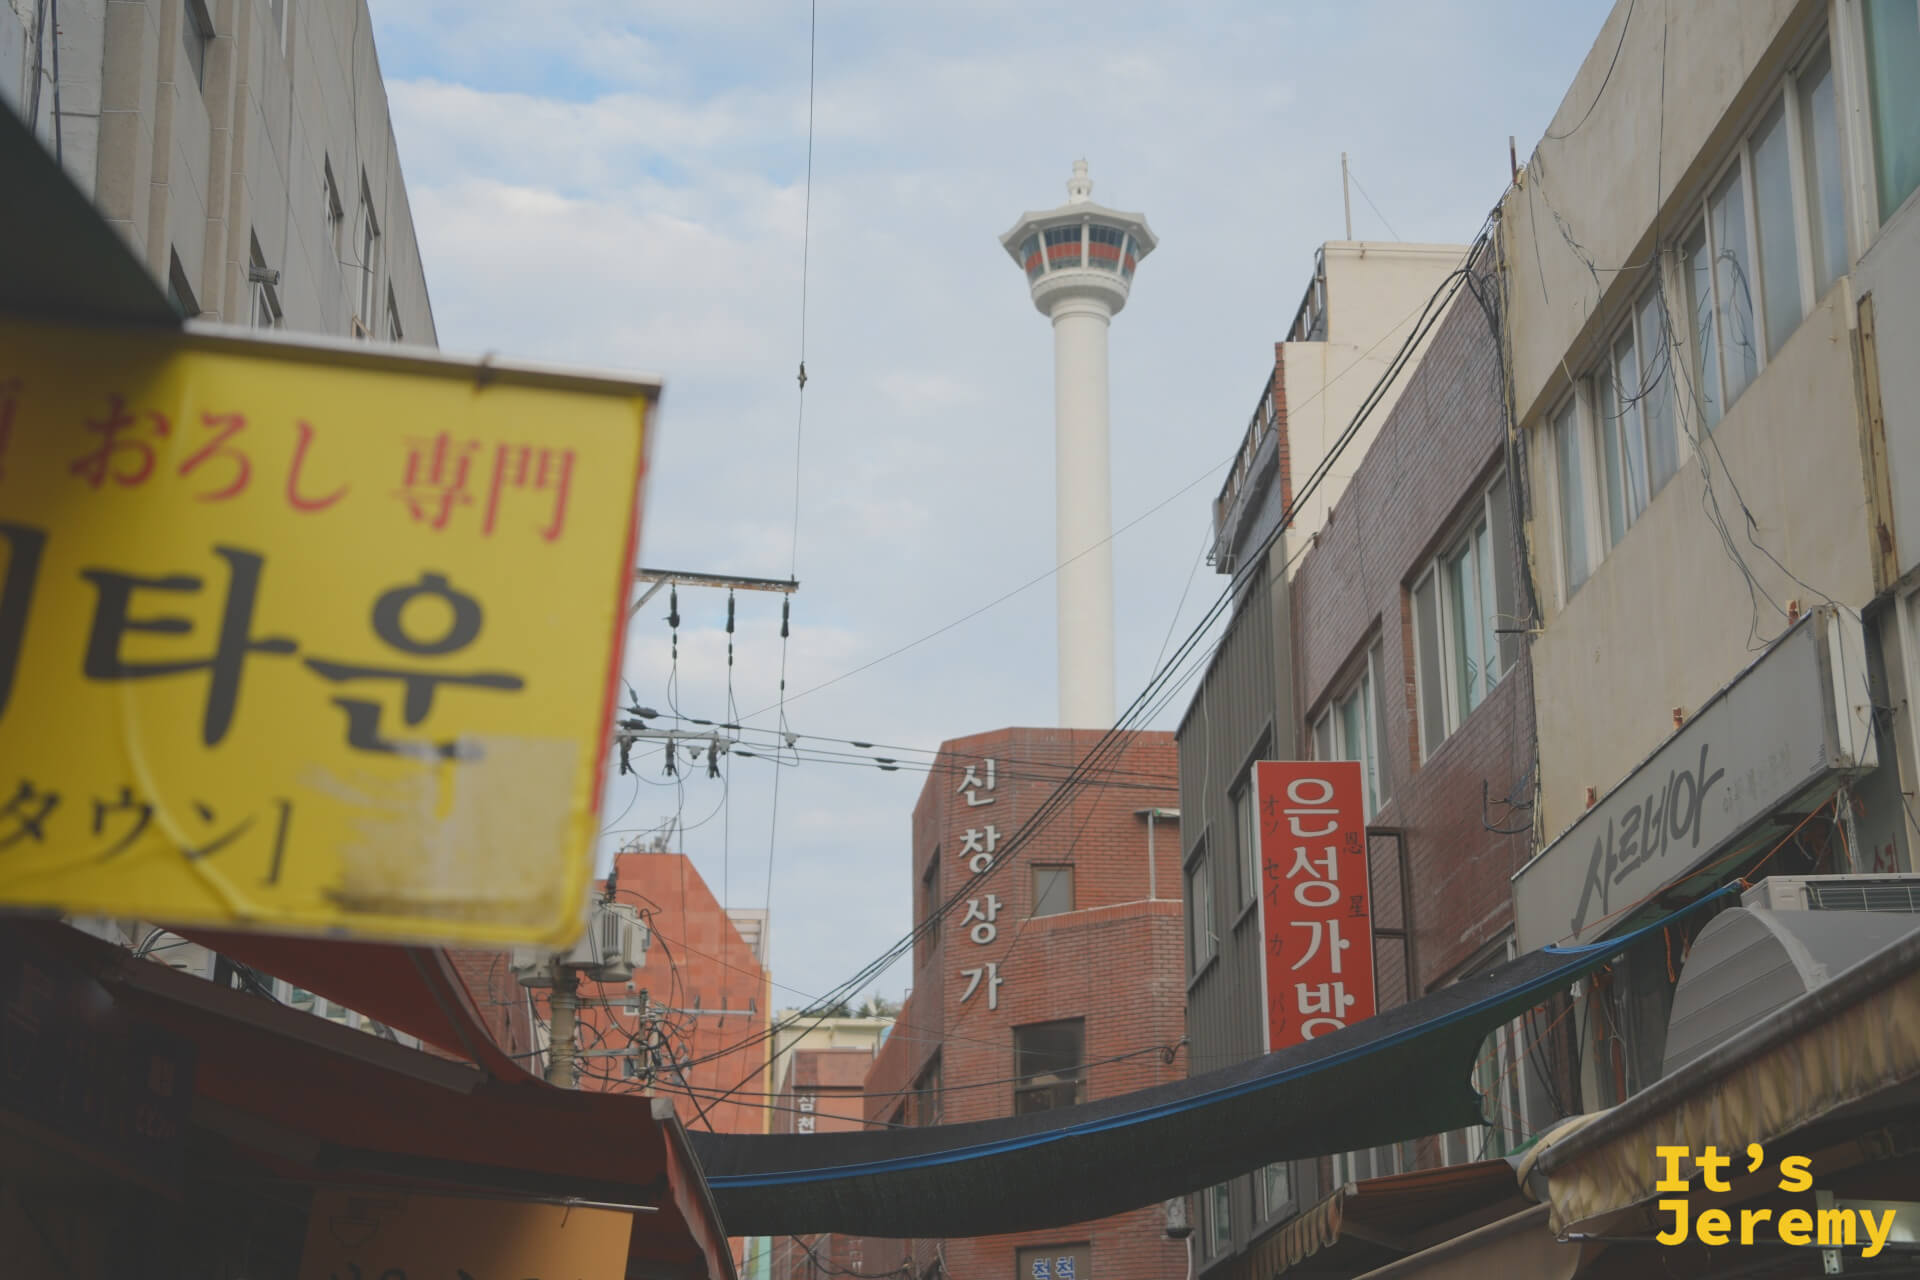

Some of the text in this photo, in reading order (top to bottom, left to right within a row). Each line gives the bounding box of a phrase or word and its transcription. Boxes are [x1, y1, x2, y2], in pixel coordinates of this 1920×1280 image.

[70, 398, 348, 512] おろし
[0, 521, 525, 760] 타운
[957, 758, 1003, 1011] 신창상가
[1283, 778, 1355, 1042] 은성가방
